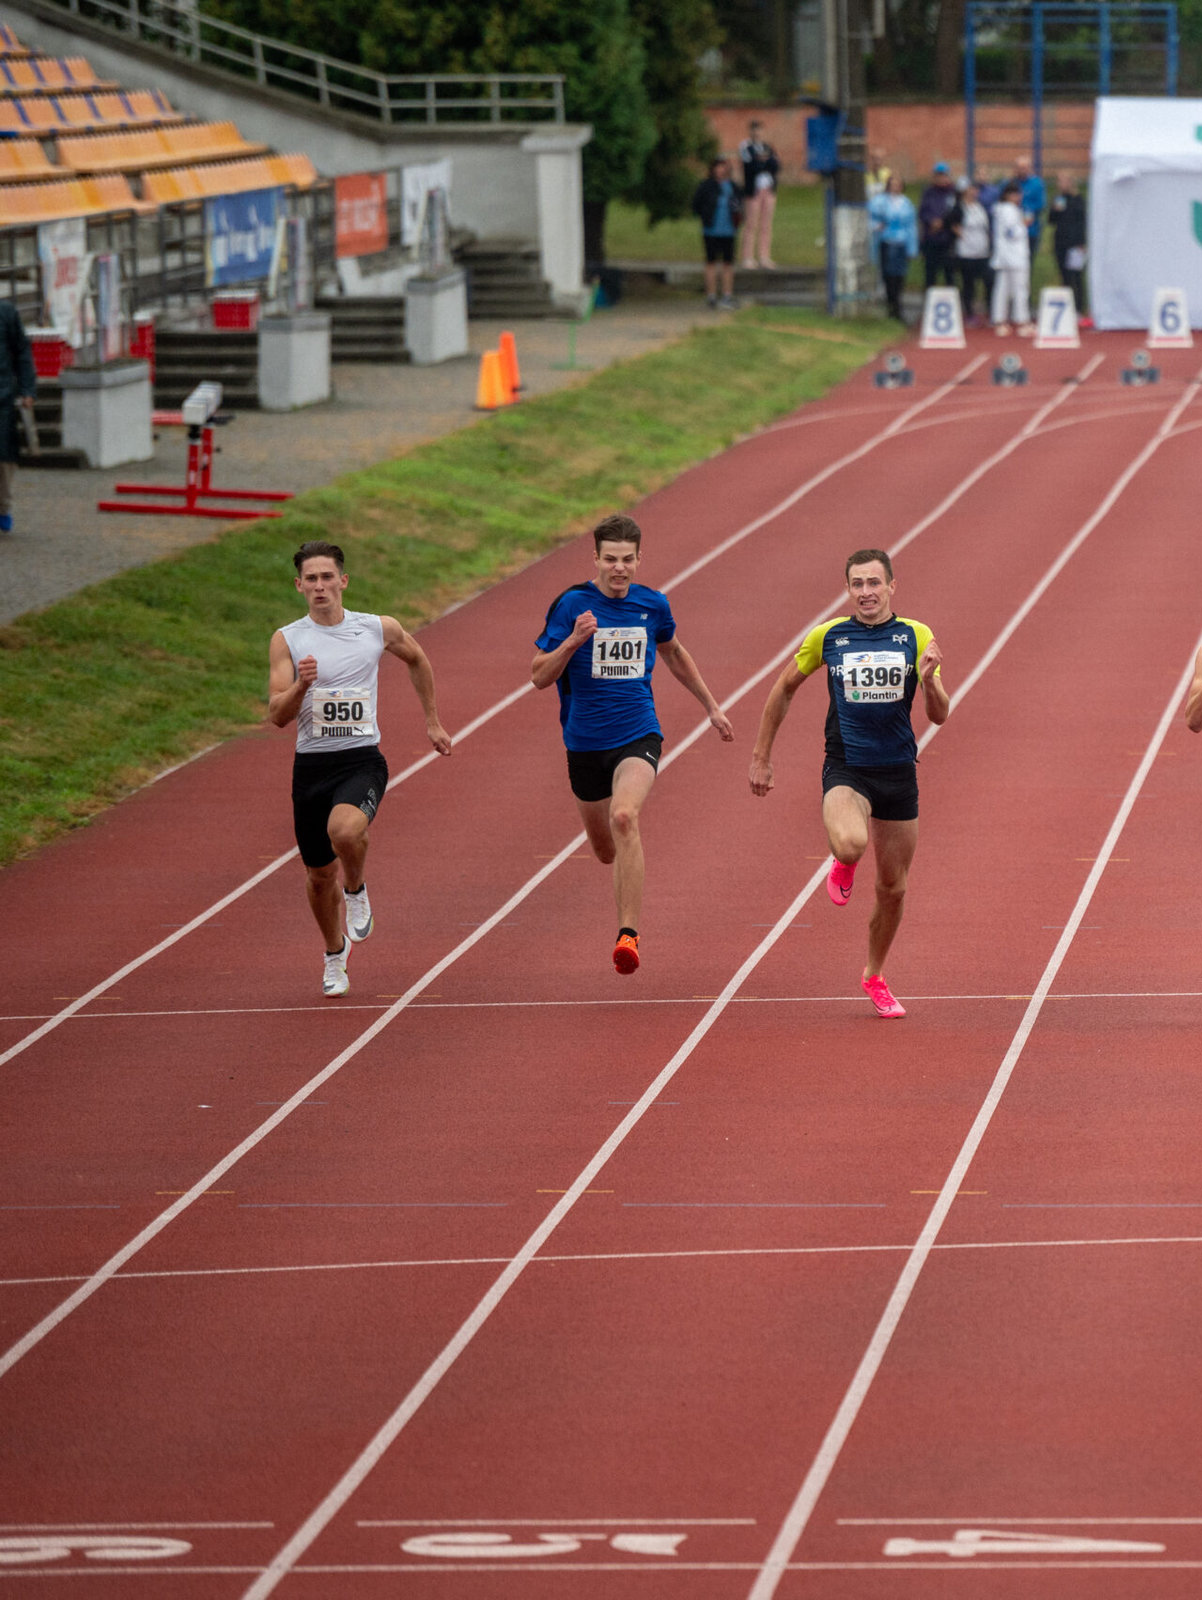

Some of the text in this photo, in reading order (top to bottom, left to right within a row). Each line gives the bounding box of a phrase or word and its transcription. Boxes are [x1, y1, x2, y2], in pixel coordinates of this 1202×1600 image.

[932, 301, 955, 334] 8
[1047, 301, 1068, 333] 7
[1159, 301, 1181, 333] 6
[597, 640, 642, 660] 1401
[600, 665, 629, 676] PUMA
[847, 666, 902, 687] 1396
[862, 691, 898, 700] Plantin
[323, 701, 363, 721] 950
[321, 726, 353, 737] PUMA
[400, 1532, 688, 1558] 5
[883, 1529, 1167, 1557] 4
